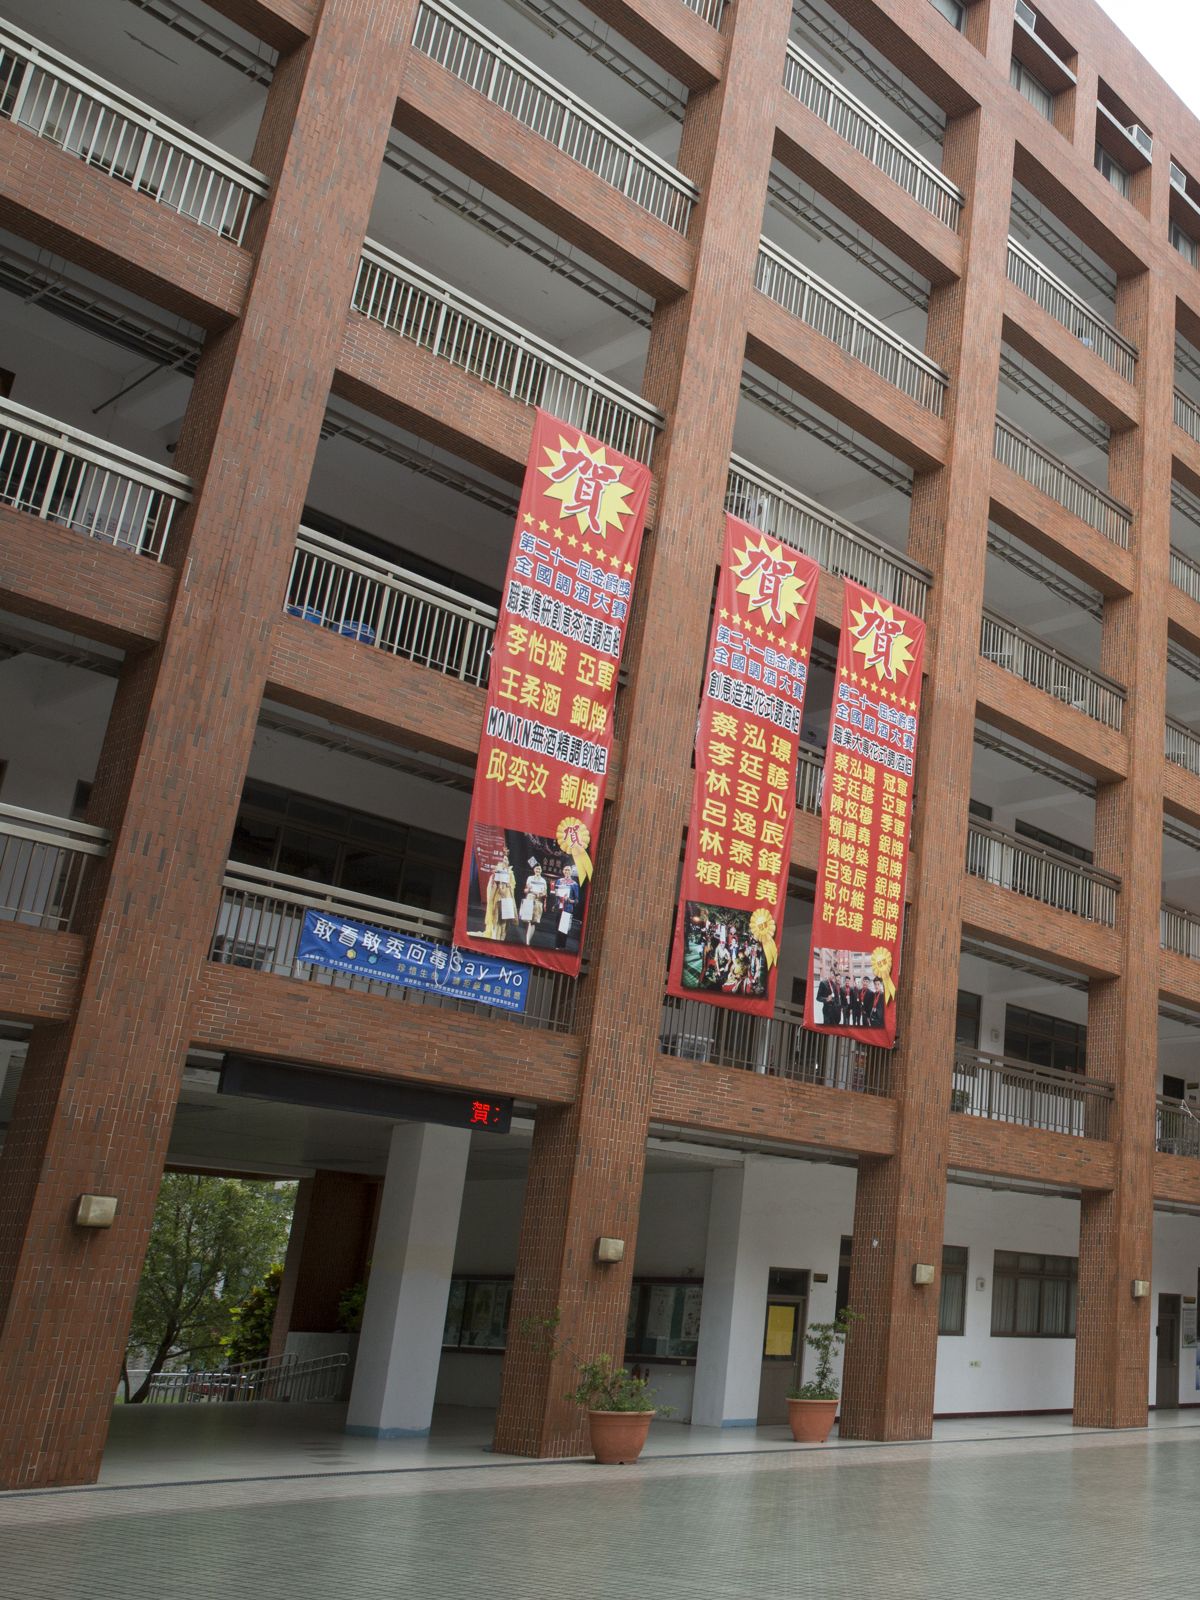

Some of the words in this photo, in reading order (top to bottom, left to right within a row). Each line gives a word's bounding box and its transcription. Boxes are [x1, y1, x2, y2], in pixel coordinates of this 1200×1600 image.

[551, 449, 620, 534] 賀
[515, 555, 627, 623] 全國調酒大賽
[740, 550, 794, 624] 賀
[507, 623, 568, 677] 李怡璇
[576, 652, 615, 692] 亞軍
[857, 610, 903, 679] 賀
[713, 647, 803, 702] 全國調酒大賽
[499, 665, 562, 717] 王柔涵
[570, 694, 607, 735] 銅牌
[706, 671, 801, 735] 創意造型花式調酒組
[836, 703, 914, 752] 全國調酒大賽
[558, 773, 598, 814] 銅牌
[705, 768, 787, 820] 林至凡
[882, 793, 906, 817] 亞軍
[883, 772, 908, 797] 冠軍
[702, 798, 784, 848] 呂逸辰
[879, 834, 904, 859] 銀牌
[881, 814, 905, 837] 季軍
[699, 827, 782, 876] 林泰鋒
[877, 855, 902, 880] 銀牌
[695, 858, 777, 905] 賴靖堯
[825, 859, 867, 890] 呂逸辰
[875, 876, 901, 901] 銀牌
[871, 919, 897, 943] 銅牌
[873, 897, 899, 921] 銀牌
[499, 966, 523, 987] No
